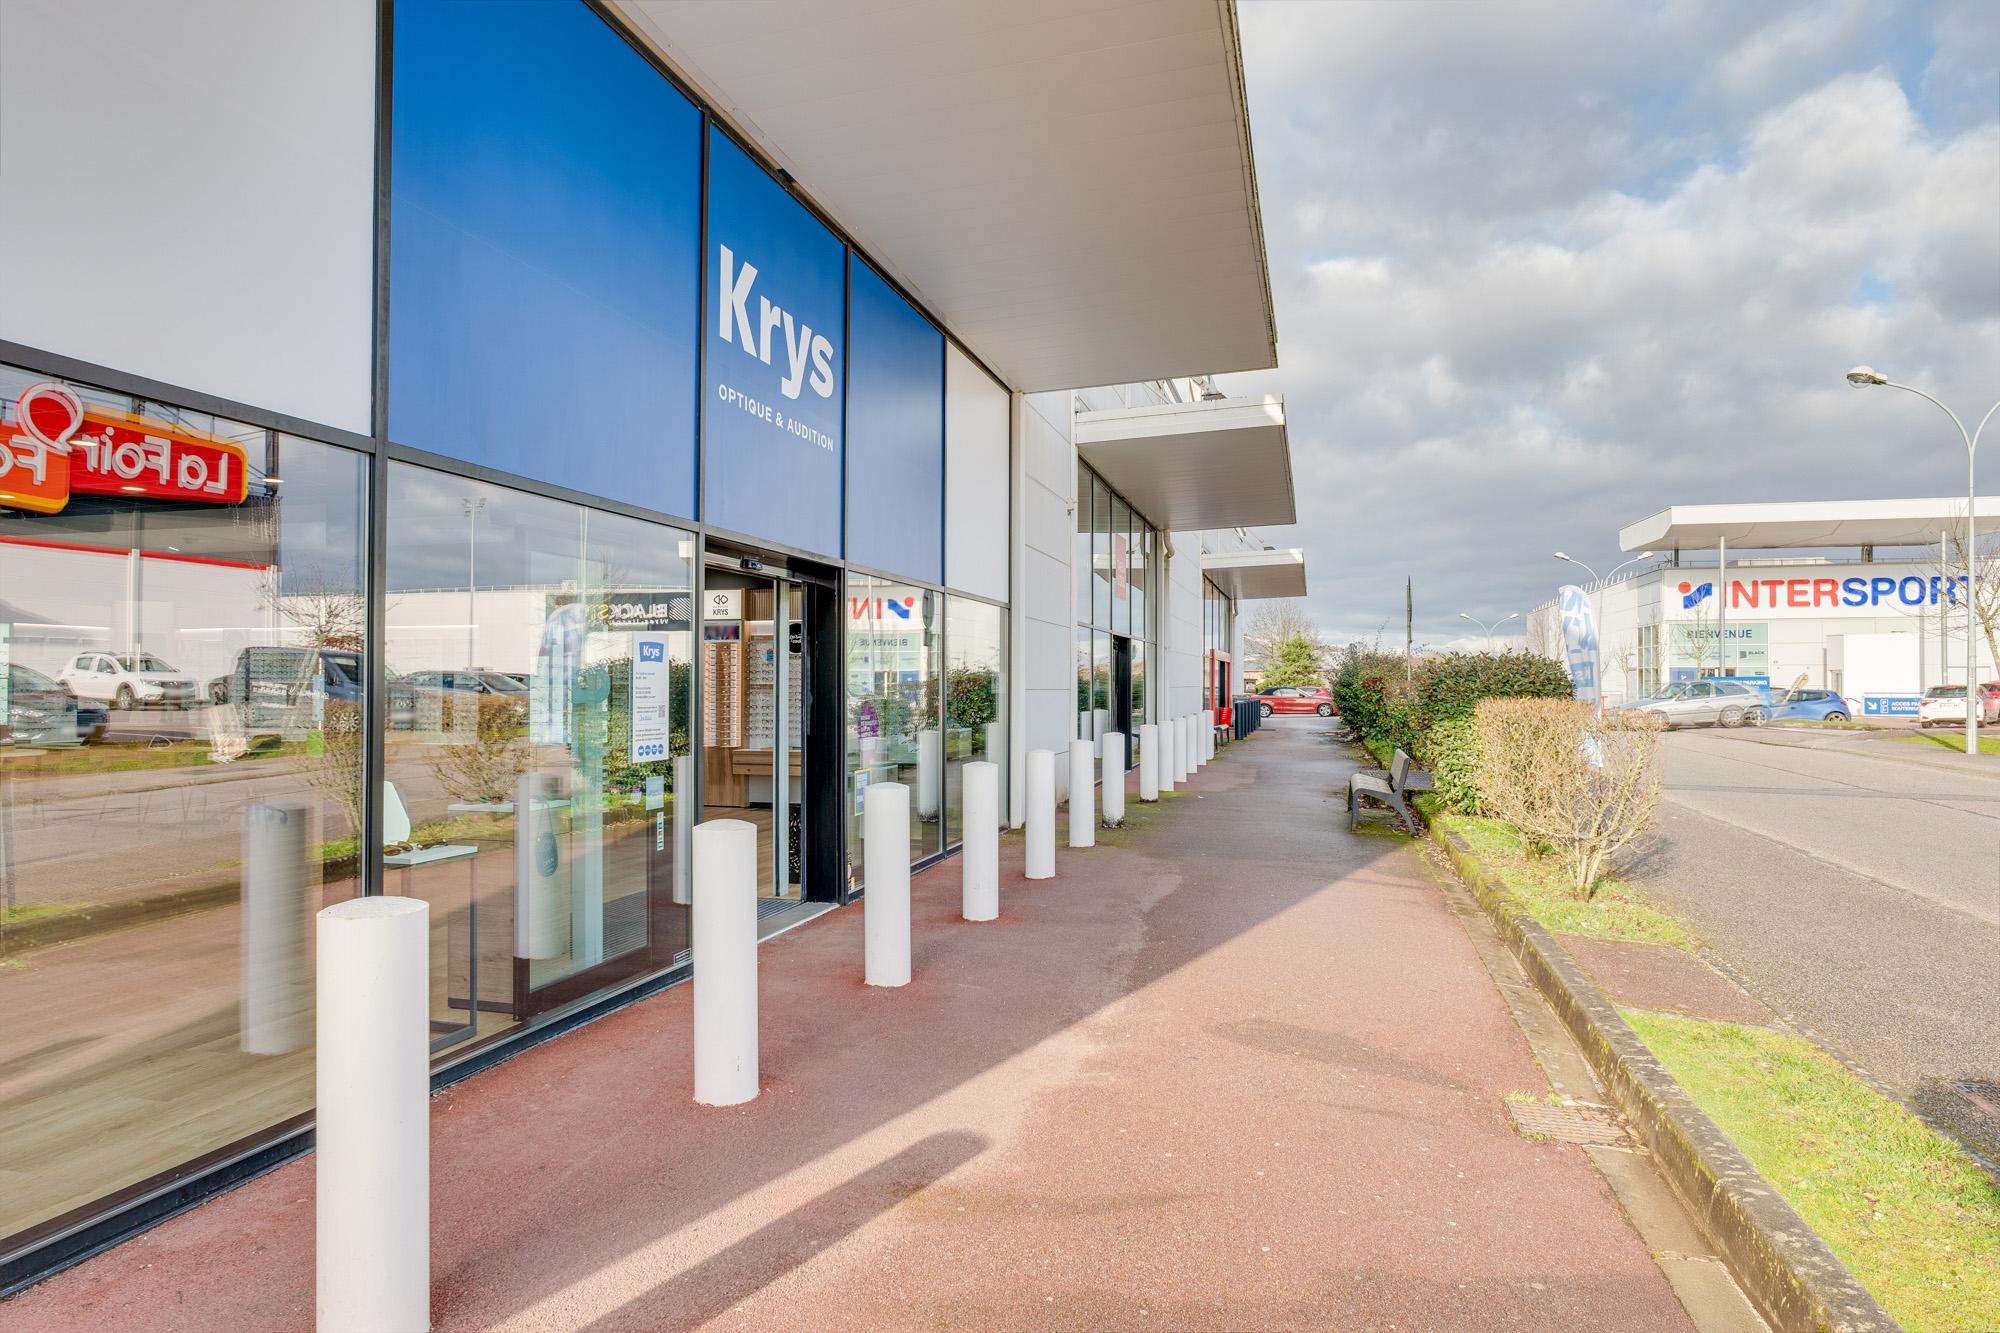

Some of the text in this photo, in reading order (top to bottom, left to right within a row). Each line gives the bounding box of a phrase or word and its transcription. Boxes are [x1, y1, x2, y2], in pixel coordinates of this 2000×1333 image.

[719, 243, 834, 400] Krys
[718, 384, 834, 452] OPTIQUE & AUDITION
[712, 608, 729, 616] KRYS
[643, 645, 660, 659] Krys
